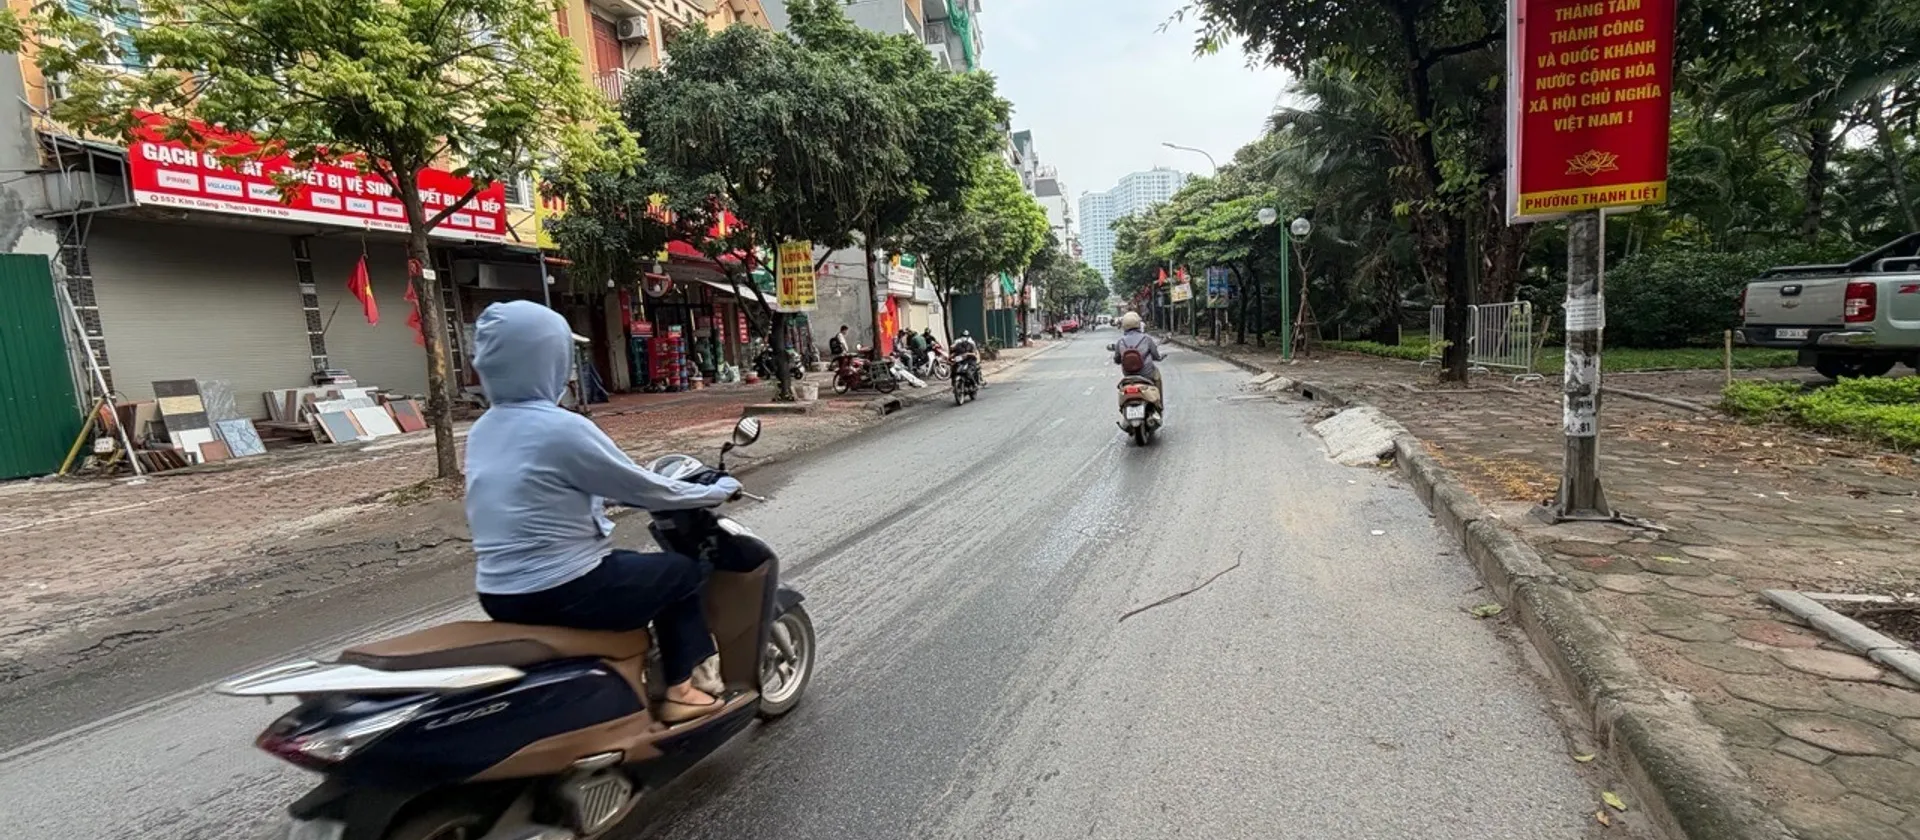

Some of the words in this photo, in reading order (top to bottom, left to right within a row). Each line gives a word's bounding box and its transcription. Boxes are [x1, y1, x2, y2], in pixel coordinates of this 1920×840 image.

[1555, 3, 1604, 22] THÁNG
[1549, 26, 1599, 44] THÀNH
[1602, 18, 1645, 37] CÔNG
[1537, 51, 1556, 68] VÀ
[1560, 45, 1600, 66] QUỐC
[1604, 39, 1656, 59] KHÁNH
[1535, 72, 1576, 91] NƯỚC
[1580, 67, 1621, 86] CỘNG
[1624, 61, 1656, 79] HÒA
[1528, 95, 1549, 114] XÃ
[1552, 93, 1577, 112] HỘI
[1581, 87, 1611, 107] CHỦ
[1614, 82, 1661, 103] NGHĨA
[1553, 114, 1585, 132] VIỆT
[1588, 111, 1623, 128] NAM
[141, 142, 198, 167] GẠCH
[327, 173, 343, 193] BỊ
[345, 176, 365, 196] VỆ
[1525, 193, 1578, 209] PHƯỜNG
[1581, 191, 1627, 204] THANH
[1630, 187, 1659, 201] LIỆT
